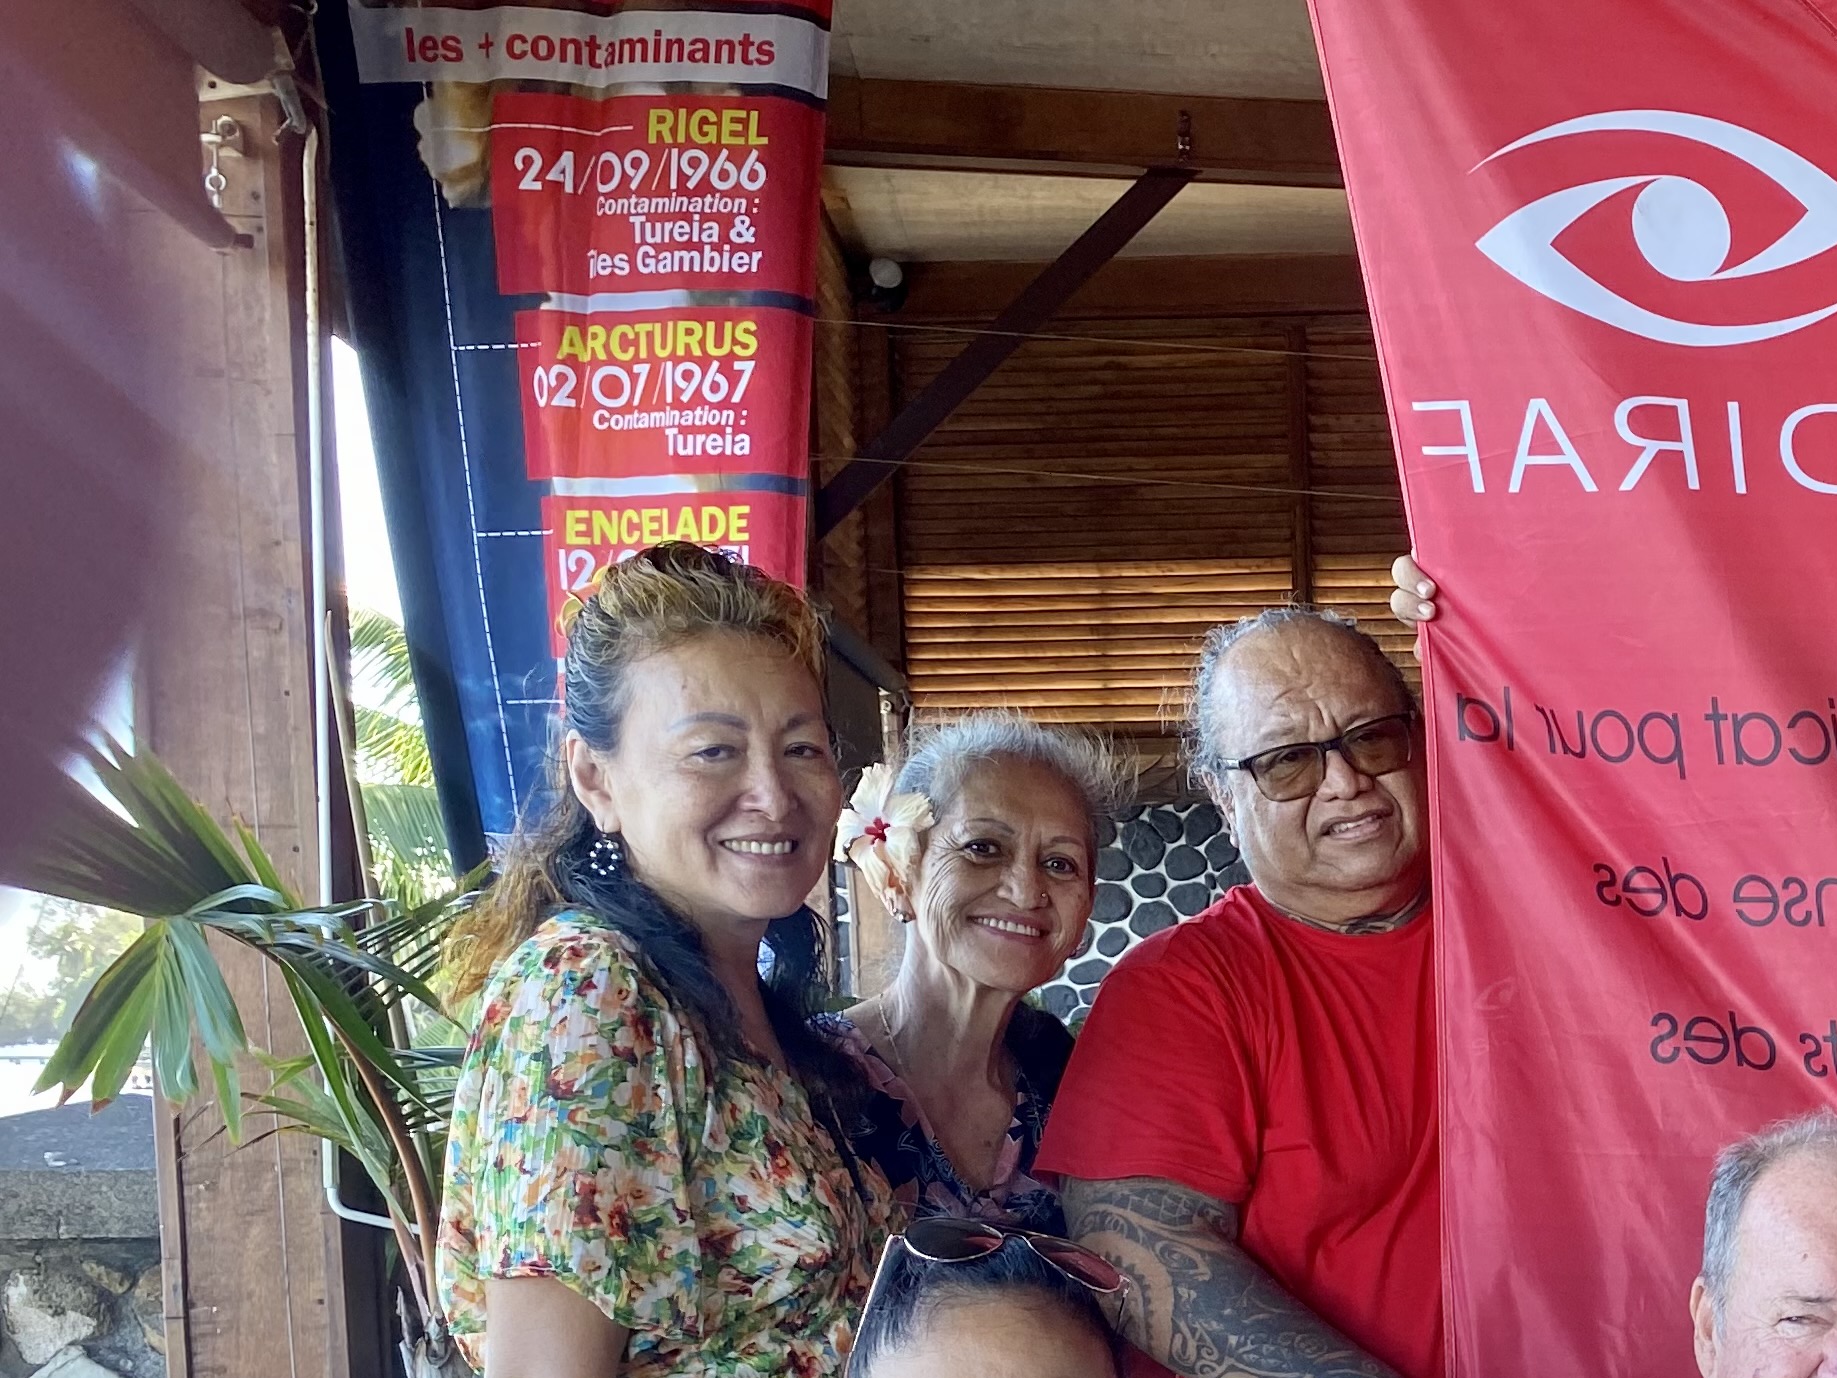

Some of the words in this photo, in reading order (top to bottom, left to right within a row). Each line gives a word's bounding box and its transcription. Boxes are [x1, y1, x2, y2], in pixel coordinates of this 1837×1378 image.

[405, 26, 463, 63] les
[478, 36, 494, 58] +
[506, 29, 775, 69] contaminants
[648, 109, 768, 144] RIGEL
[514, 147, 767, 195] 24/09/1966
[596, 193, 747, 216] Contamination
[629, 214, 719, 244] Tureia
[729, 214, 756, 244] &
[636, 244, 762, 274] Gambier
[556, 320, 758, 361] ARCTURUS
[533, 360, 756, 408] 02/07/1967
[592, 407, 734, 430] Contamination
[665, 427, 750, 457] Tureia
[566, 505, 750, 545] ENCELADE
